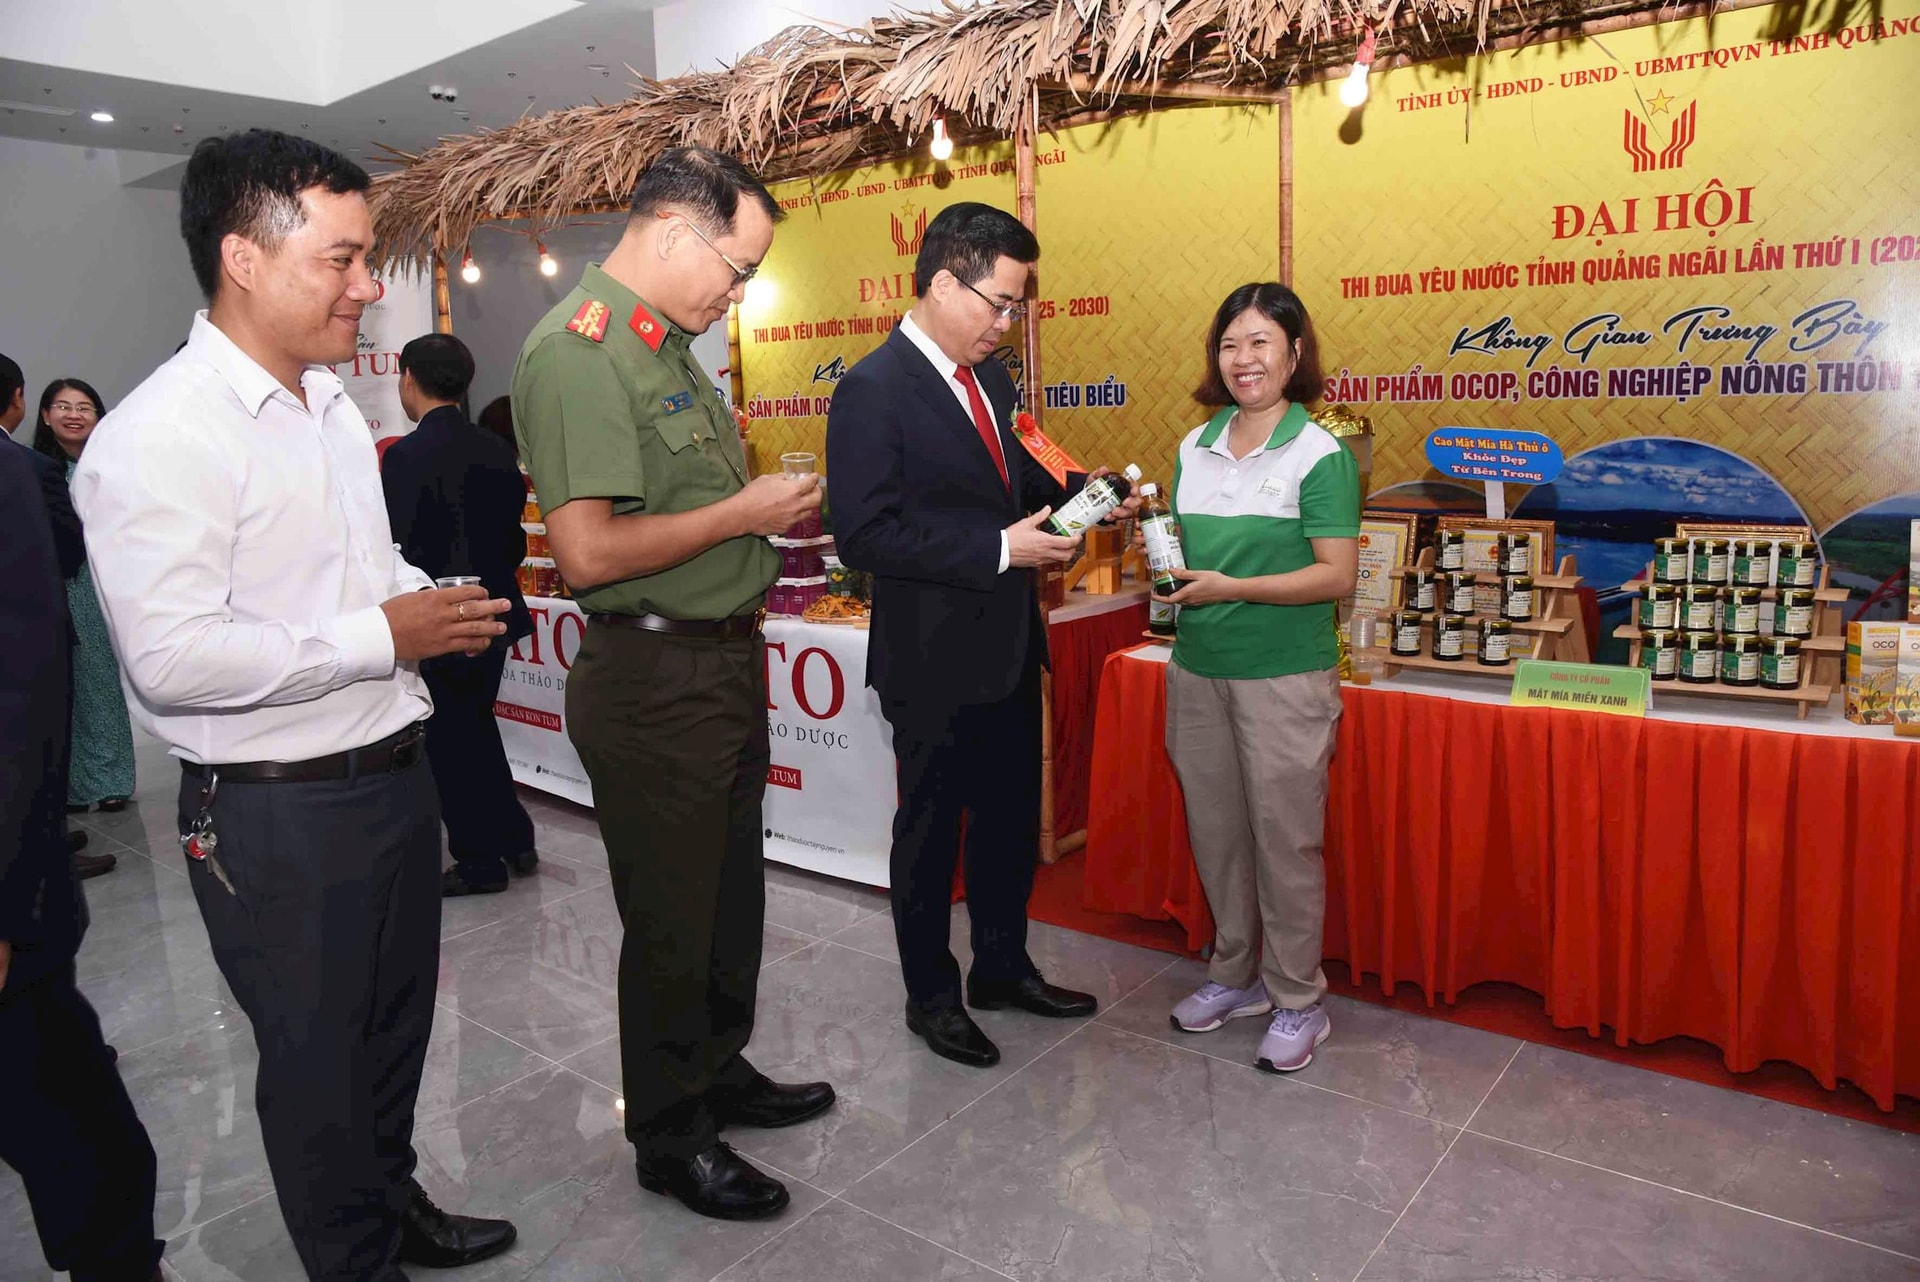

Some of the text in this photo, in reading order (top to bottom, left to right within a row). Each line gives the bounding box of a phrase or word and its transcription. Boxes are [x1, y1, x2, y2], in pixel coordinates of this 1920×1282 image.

[1397, 91, 1443, 112] TỈNH
[1447, 86, 1474, 105] ỦY
[1487, 77, 1543, 99] HĐND
[1560, 66, 1618, 88] UBND
[1635, 43, 1762, 77] UBMTTQVN
[1768, 32, 1830, 57] TỈNH
[821, 189, 849, 204] HĐND
[857, 183, 885, 198] UBND
[958, 160, 987, 179] TỈNH
[1035, 149, 1067, 167] NGÃI
[1551, 178, 1756, 247] ĐẠI HỘI
[1341, 276, 1369, 299] THI
[1375, 273, 1413, 297] ĐUA
[1419, 266, 1456, 293] YÊU
[1462, 262, 1519, 291] NƯỚC
[1526, 256, 1576, 287] TỈNH
[1582, 249, 1661, 285] QUẢNG
[1668, 245, 1727, 277] NGÃI
[1735, 238, 1785, 273] LẦN
[1793, 235, 1846, 269] THỨ
[1851, 239, 1861, 265] I
[859, 273, 902, 307] ĐẠI
[754, 328, 769, 343] THI
[771, 325, 791, 342] ĐUA
[793, 321, 812, 340] YÊU
[816, 317, 845, 338] NƯỚC
[848, 314, 873, 335] TỈNH
[1069, 296, 1109, 317] 2030)
[1450, 299, 1890, 368] Không Gian Trưng Bày
[748, 395, 774, 418] SẢN
[776, 391, 811, 417] PHẨM
[1044, 382, 1080, 408] TIÊU
[1086, 375, 1126, 407] BIỂU
[1324, 370, 1369, 403] SẢN
[1375, 365, 1443, 402] PHẨM
[1451, 373, 1520, 403] OCOP,
[1528, 366, 1599, 399] CÔNG
[1608, 362, 1711, 402] NGHIỆP
[1721, 358, 1807, 395] NÔNG
[1817, 355, 1903, 393] THÔN
[1433, 436, 1453, 447] Cao
[1500, 440, 1513, 451] Hà
[1500, 455, 1527, 465] Đẹp
[1472, 466, 1497, 476] Bên
[1501, 469, 1542, 481] Trong
[510, 607, 587, 672] TO
[1872, 640, 1897, 649] OCO
[521, 671, 552, 689] THẢO
[763, 641, 845, 720] TO
[1528, 687, 1549, 701] MẬT
[1600, 695, 1628, 707] XANH
[525, 710, 541, 723] KON
[542, 715, 559, 728] TUM
[796, 726, 849, 750] DƯỢC
[772, 769, 798, 785] TUM
